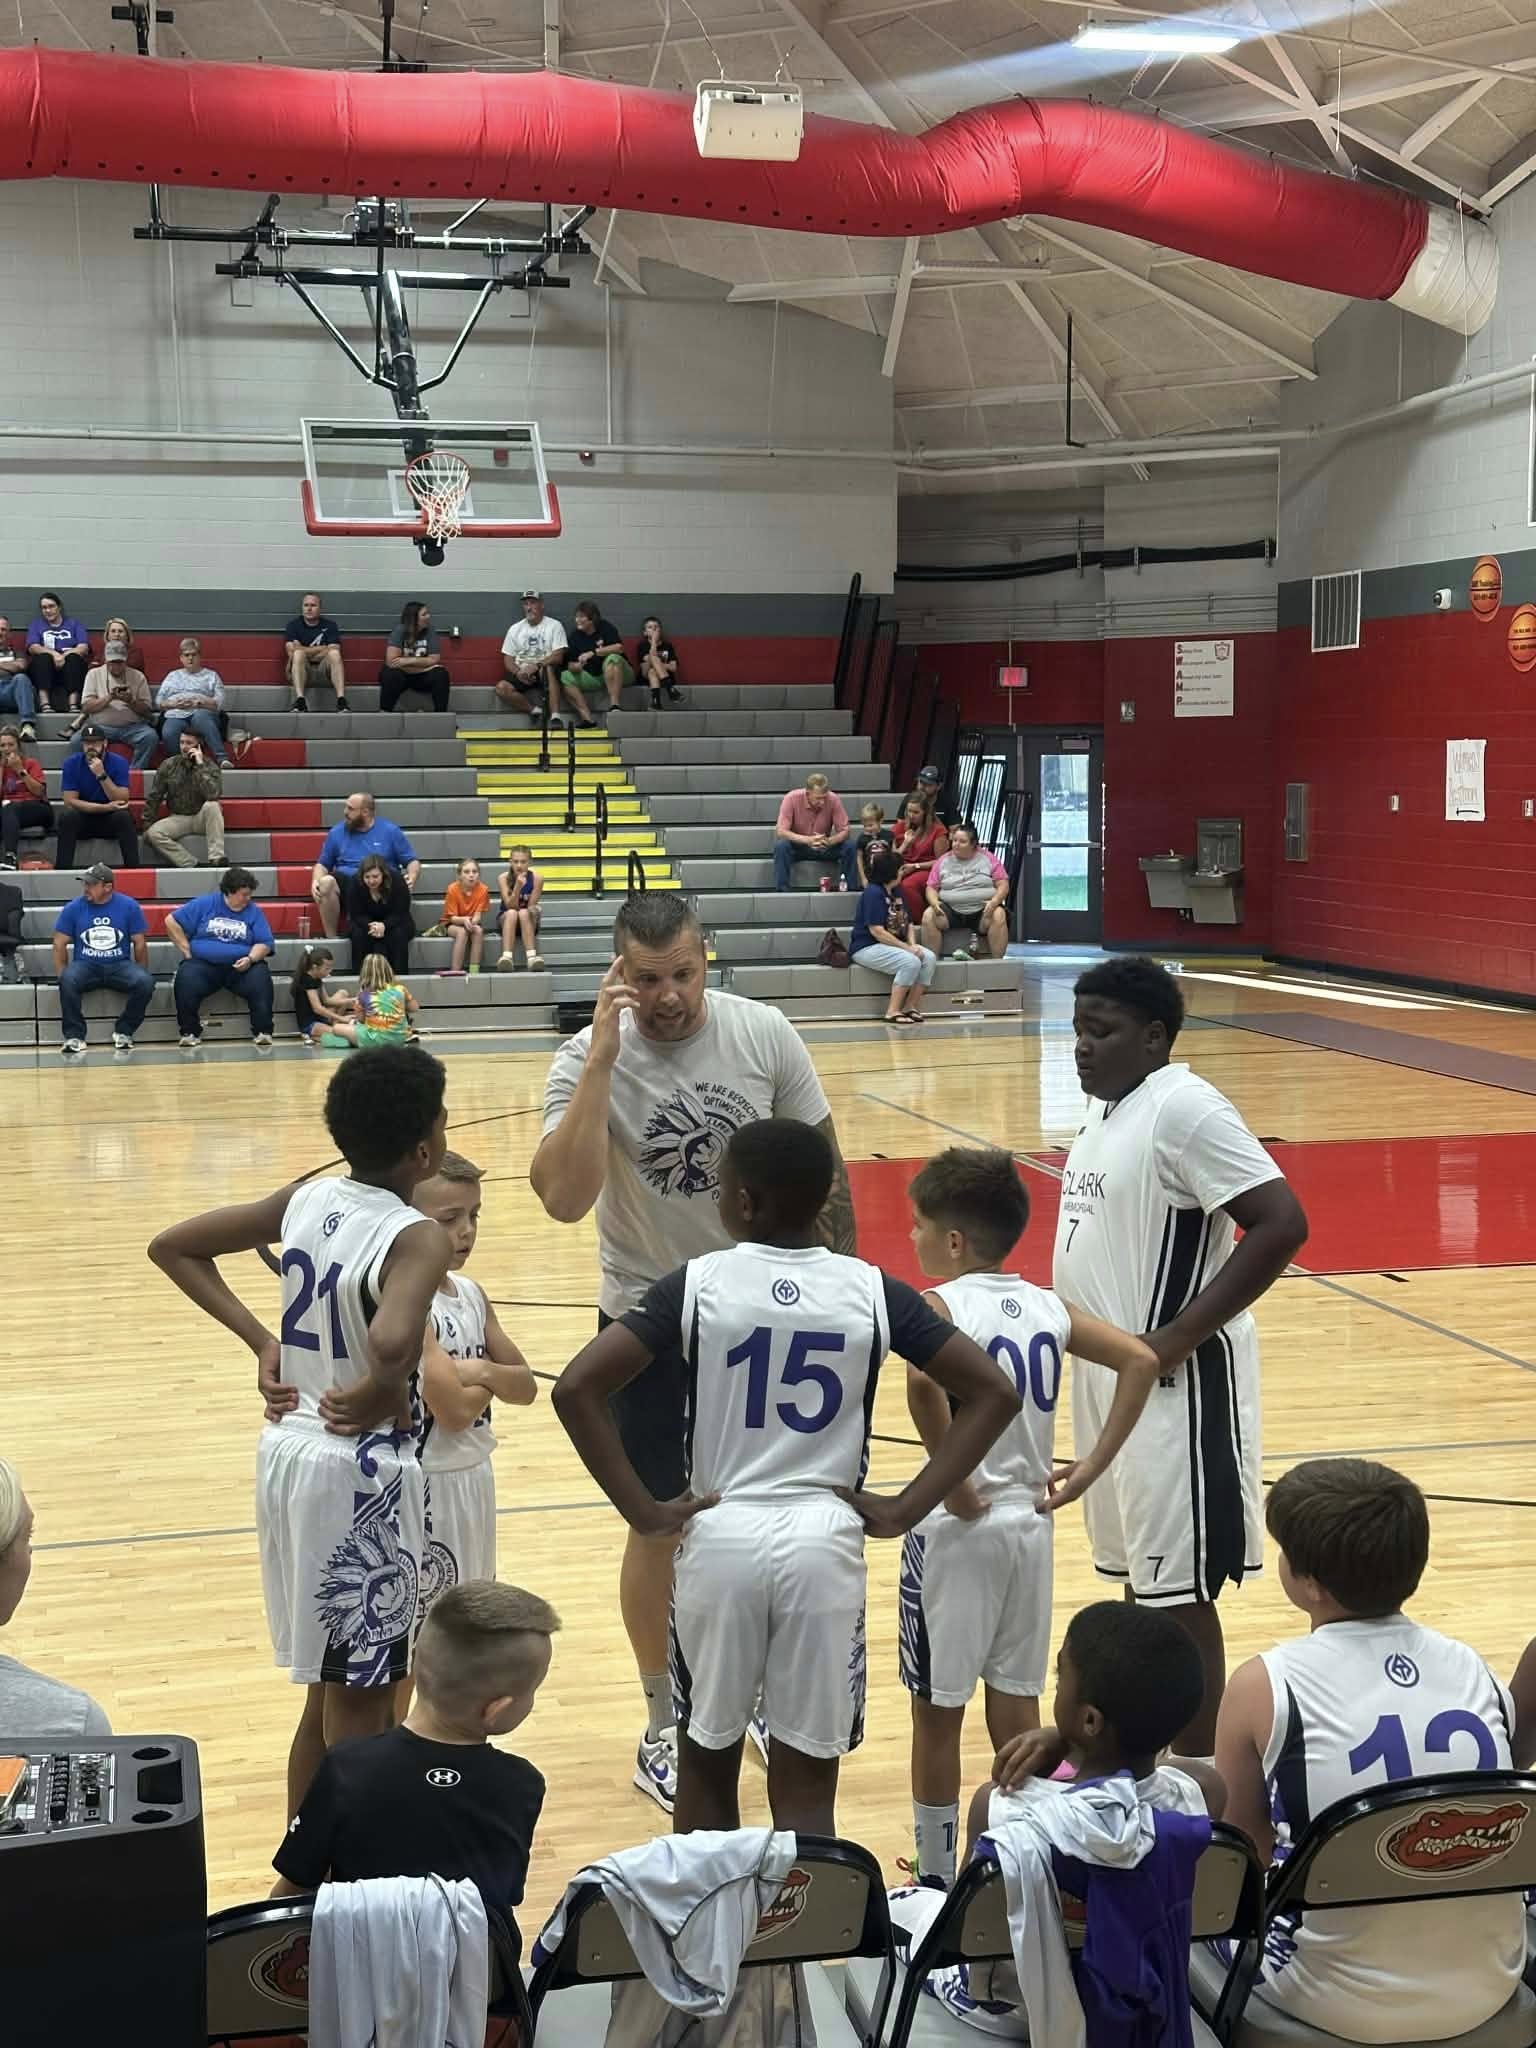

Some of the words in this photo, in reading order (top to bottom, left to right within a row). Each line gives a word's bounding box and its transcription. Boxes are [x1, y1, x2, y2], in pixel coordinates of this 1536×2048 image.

[93, 916, 111, 926] GO
[81, 946, 123, 958] HORNETS
[696, 1082, 709, 1093] WE
[711, 1083, 728, 1096] ARE
[1062, 1170, 1107, 1200] CLARK
[1066, 1218, 1080, 1253] 7
[281, 1248, 349, 1359] 21
[727, 1326, 846, 1434] 15
[1147, 1556, 1164, 1582] 7
